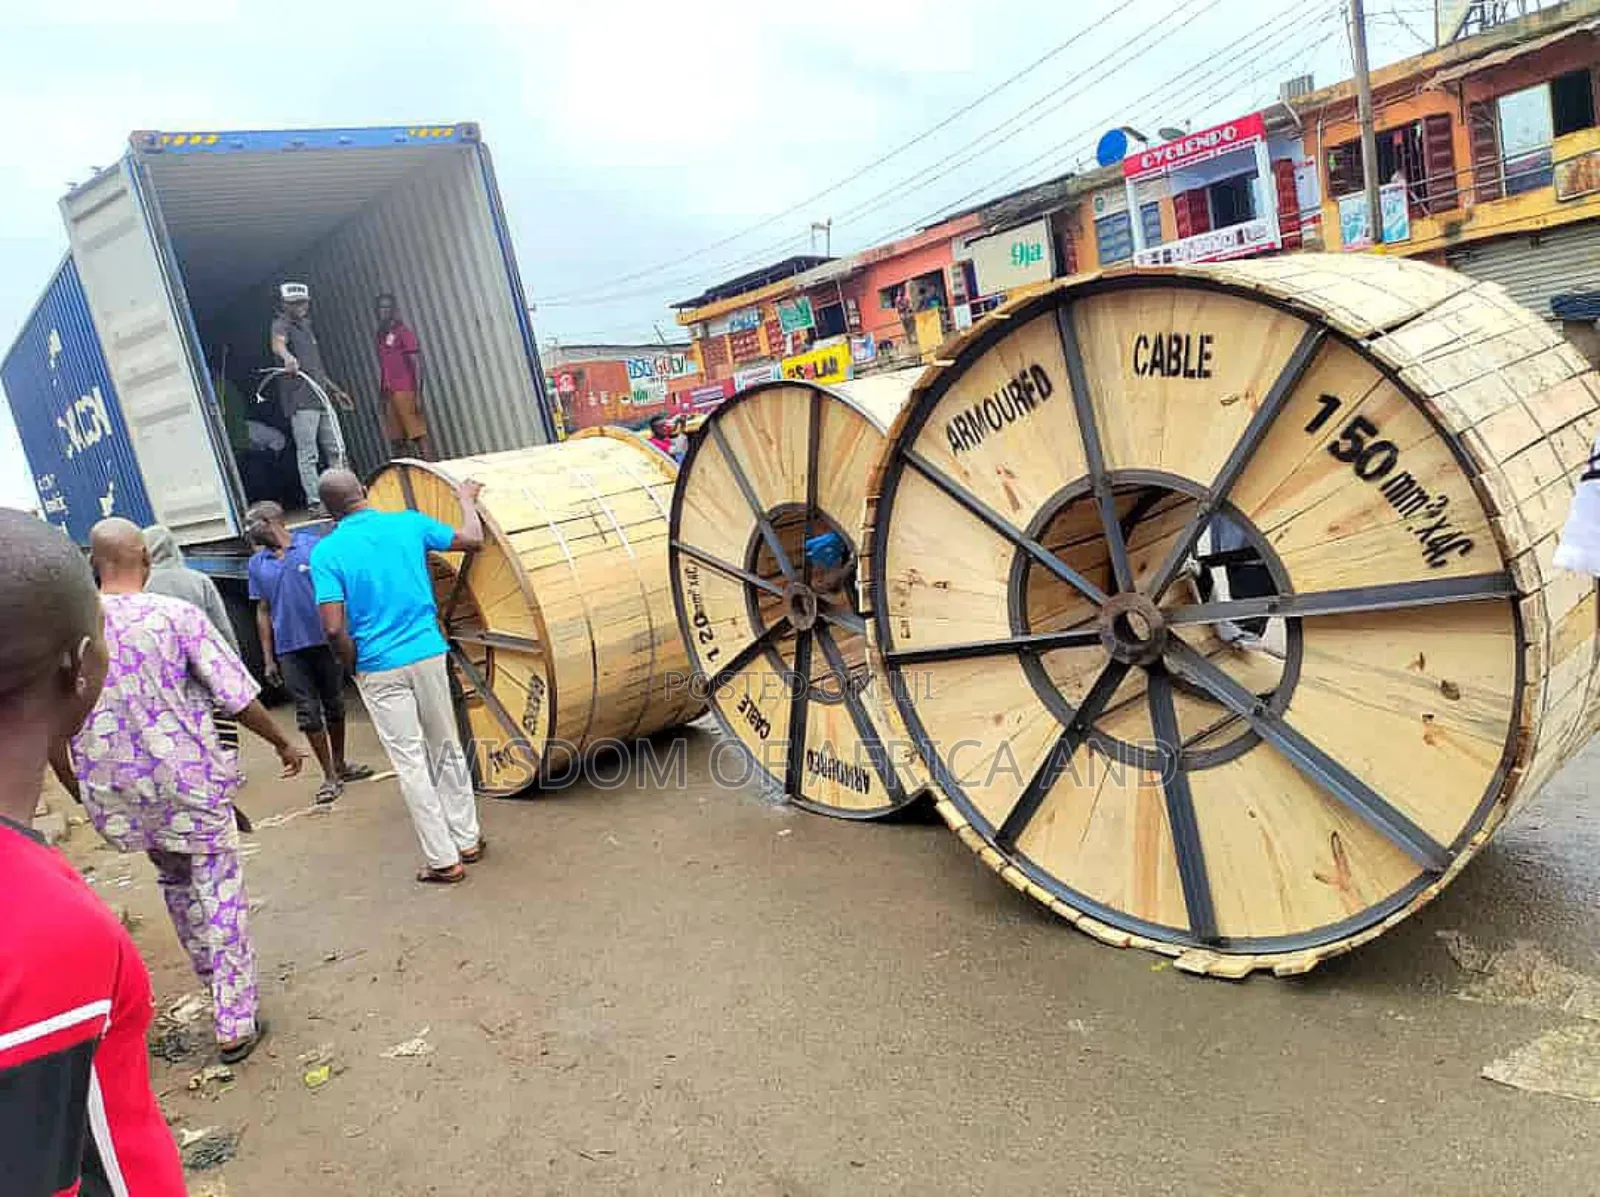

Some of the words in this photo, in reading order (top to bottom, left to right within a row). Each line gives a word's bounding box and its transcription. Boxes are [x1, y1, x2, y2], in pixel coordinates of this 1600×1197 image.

[1133, 332, 1214, 380] CABLE
[945, 363, 1053, 455] ARMOURED
[737, 695, 771, 739] CABLE
